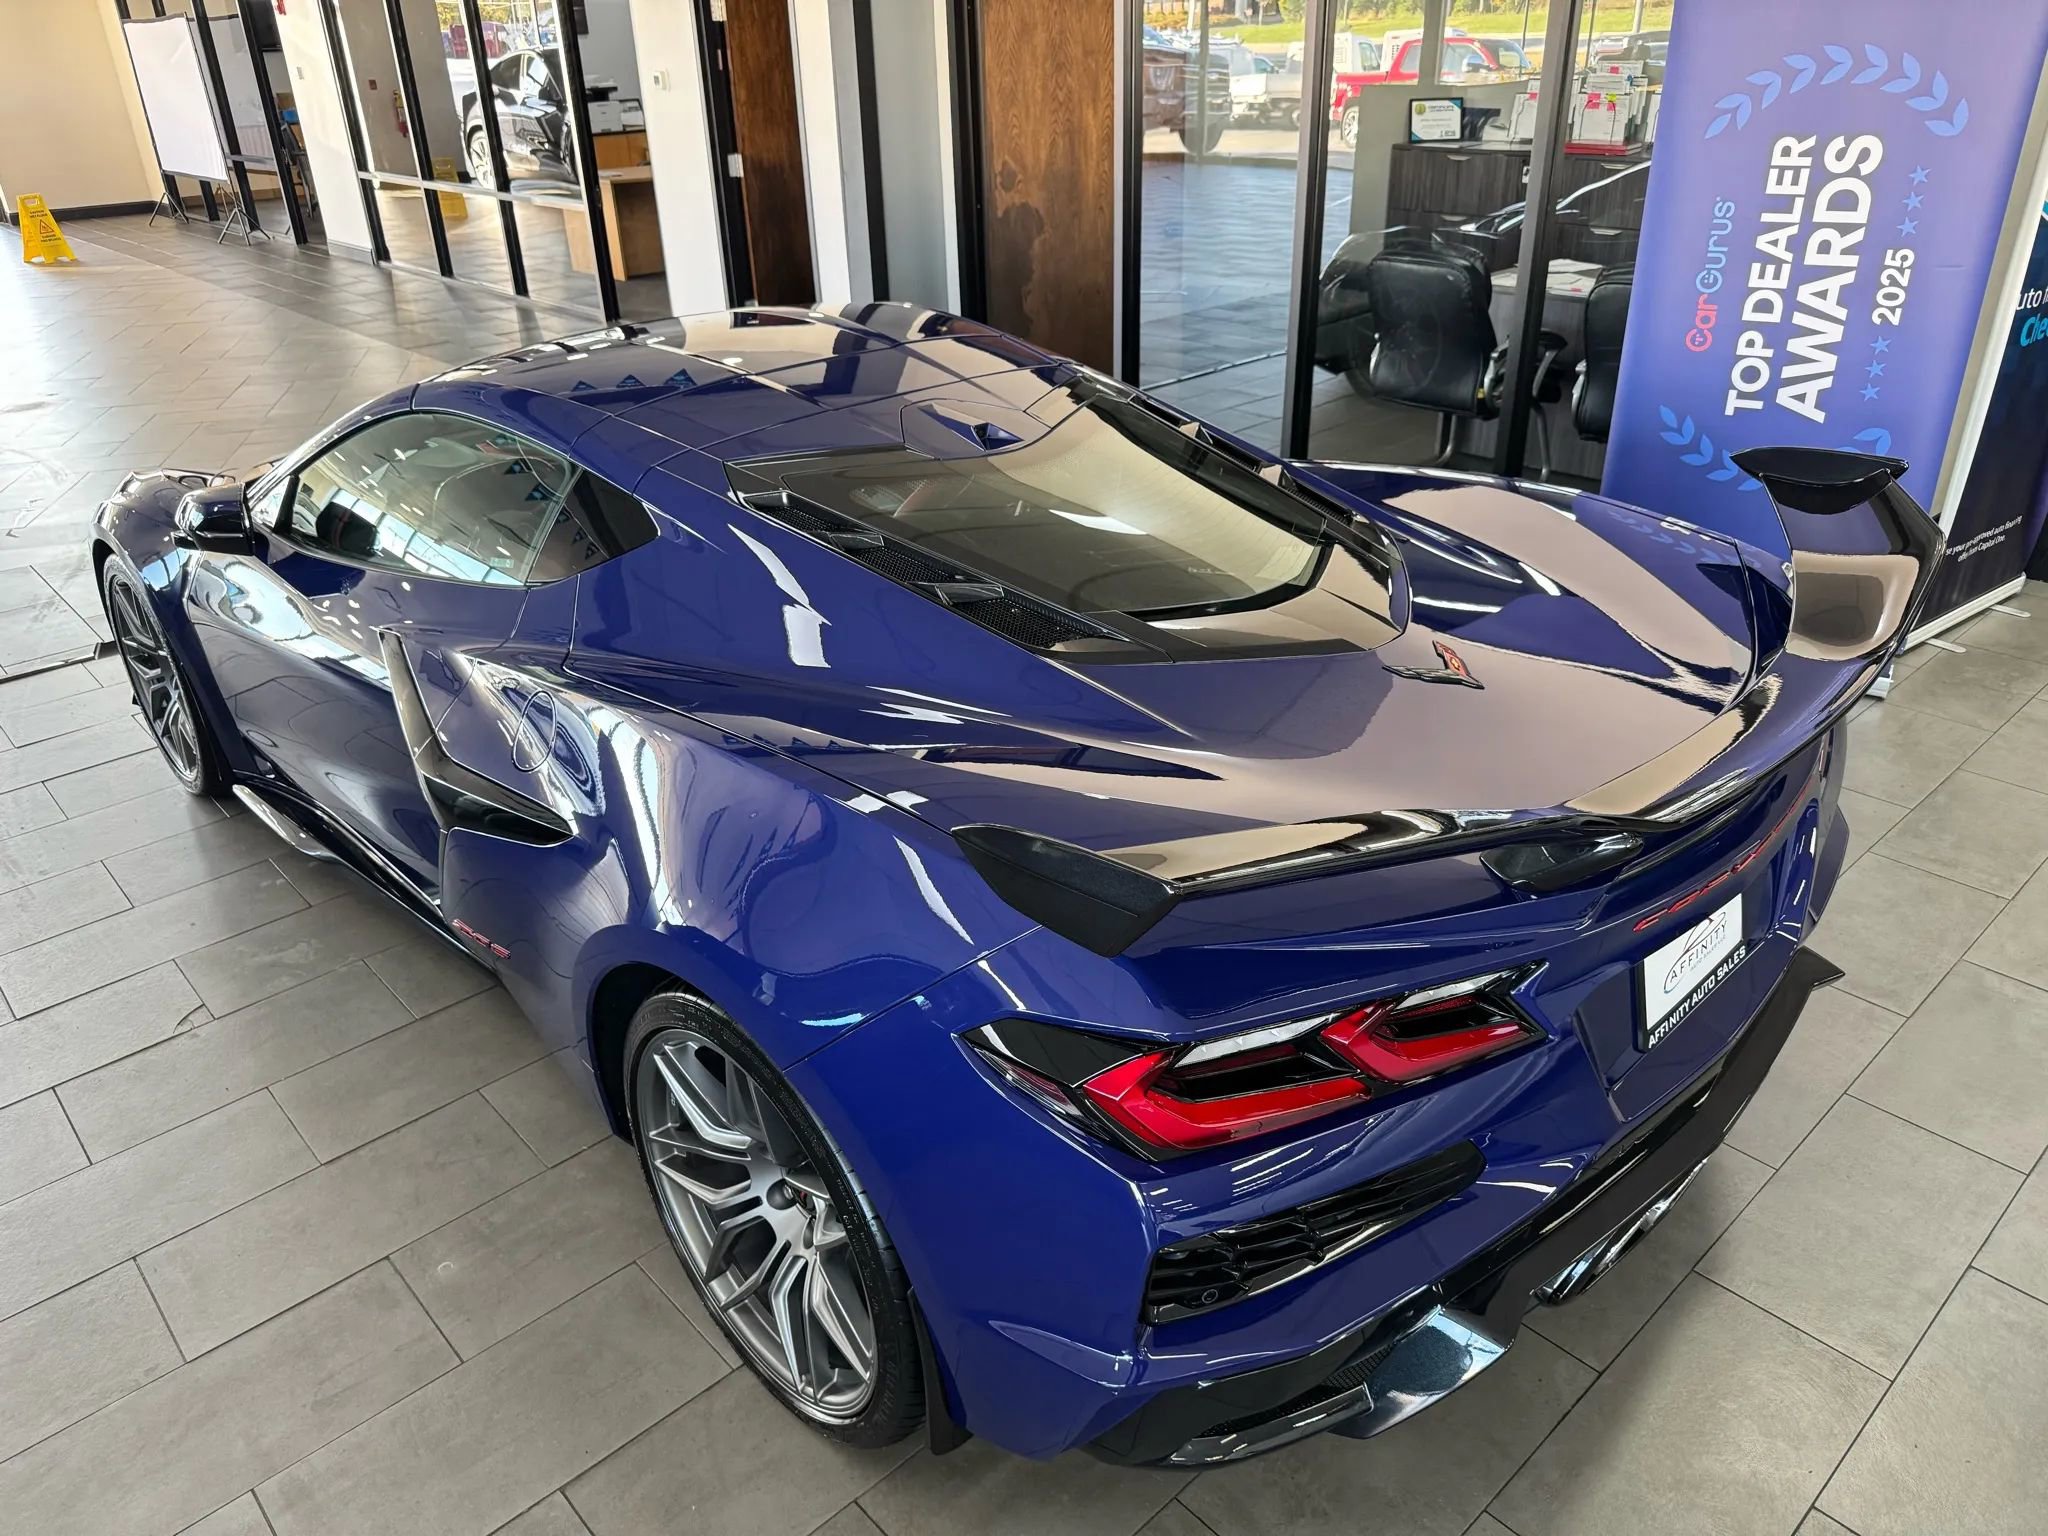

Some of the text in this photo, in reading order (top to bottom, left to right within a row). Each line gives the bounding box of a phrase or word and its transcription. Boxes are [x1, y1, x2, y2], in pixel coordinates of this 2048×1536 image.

[1685, 200, 1736, 352] CarGurus
[1725, 135, 1817, 416] TOP DEALER
[1775, 134, 1884, 424] AWARDS
[1872, 248, 1915, 326] 2025
[2017, 288, 2043, 310] uto
[1648, 1002, 1690, 1049] AFFINITY
[1691, 974, 1716, 1007] AUTO
[1716, 945, 1746, 982] SALES
[1670, 920, 1727, 984] AFFINITY
